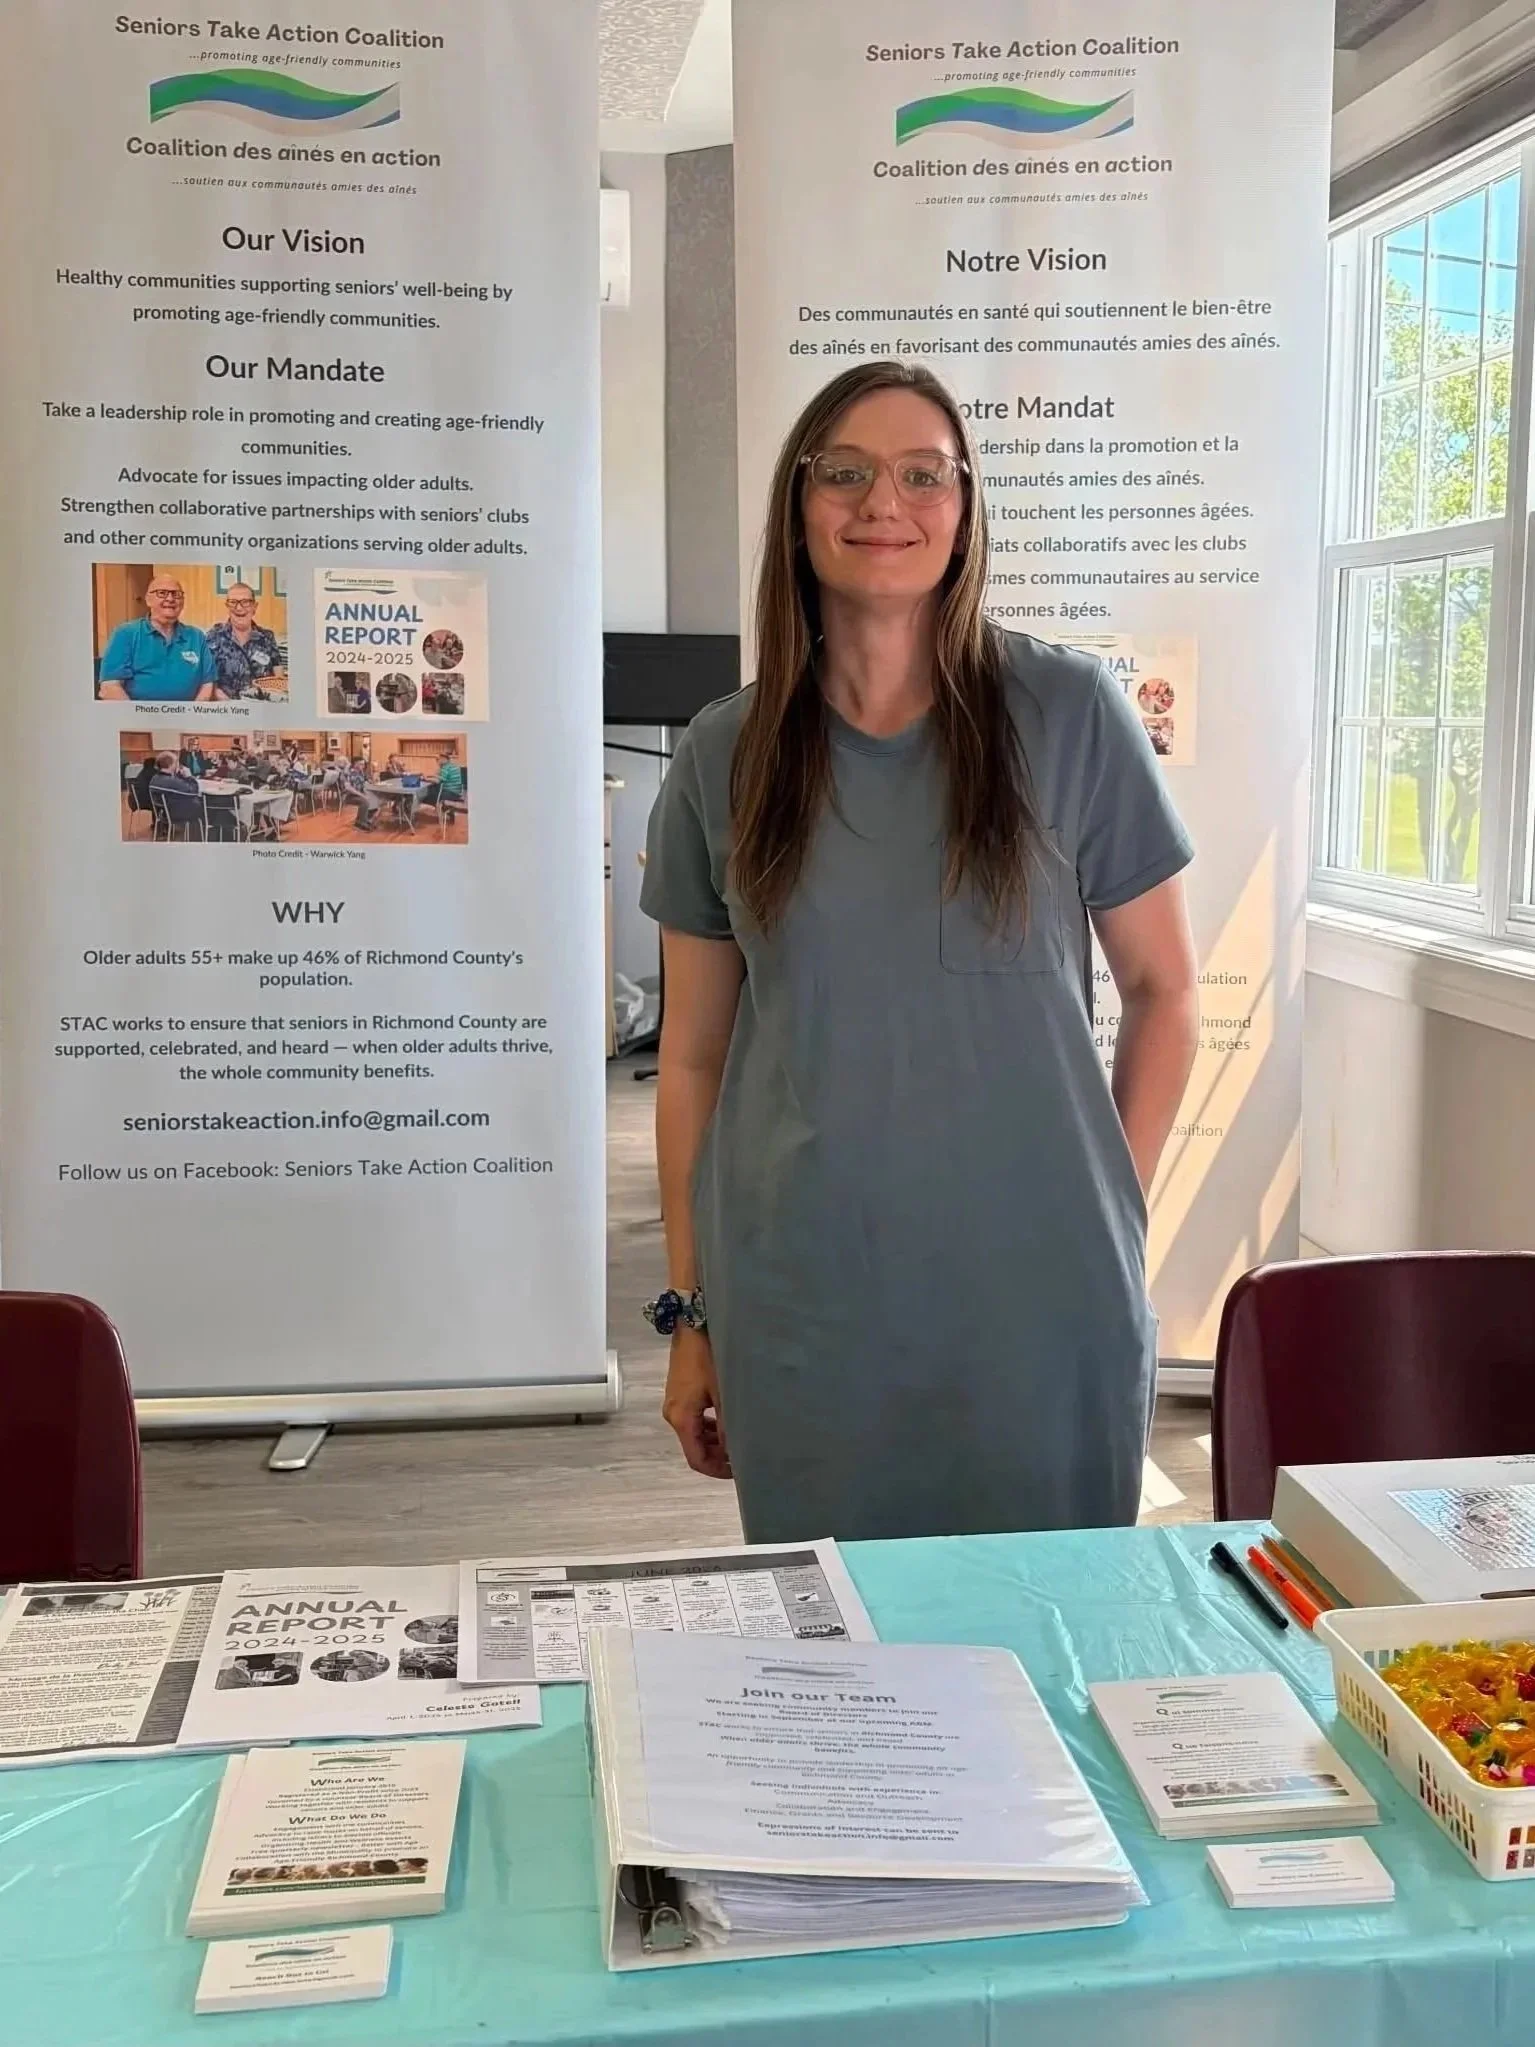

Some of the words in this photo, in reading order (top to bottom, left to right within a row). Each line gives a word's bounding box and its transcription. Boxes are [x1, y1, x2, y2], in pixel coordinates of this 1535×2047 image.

[114, 15, 201, 37] Seniors
[206, 19, 261, 41] Take
[265, 23, 339, 44] Action
[344, 27, 444, 49] Coalition
[865, 42, 946, 62] Seniors
[951, 41, 1002, 60] Take
[1005, 39, 1077, 59] Action
[1082, 36, 1179, 56] Coalition
[261, 53, 330, 68] age-friendly
[331, 55, 401, 70] communities
[1001, 69, 1066, 83] age-friendly
[1068, 66, 1137, 81] communities
[126, 136, 228, 158] Coalition
[232, 141, 273, 161] des
[277, 143, 336, 163] aînés
[339, 150, 367, 164] en
[371, 148, 441, 167] action
[873, 159, 968, 178] Coalition
[972, 158, 1010, 176] des
[1014, 156, 1070, 176] aînés
[1074, 160, 1100, 174] en
[1104, 154, 1173, 174] action
[227, 175, 248, 189] aux
[251, 175, 328, 191] communautés
[330, 183, 363, 193] amies
[366, 183, 385, 193] des
[388, 184, 417, 195] aînés
[222, 226, 276, 252] Our
[281, 228, 365, 255] Vision
[946, 249, 1020, 273] Notre
[1026, 247, 1107, 271] Vision
[56, 268, 124, 289] Healthy
[127, 273, 236, 291] communities
[240, 277, 332, 297] supporting
[334, 279, 399, 296] seniors'
[402, 281, 489, 302] well-being
[492, 283, 513, 302] by
[133, 304, 221, 325] promoting
[224, 307, 326, 328] age-friendly
[329, 312, 441, 329] communities.
[798, 306, 831, 322] Des
[835, 304, 954, 322] communautés
[957, 308, 979, 320] en
[983, 303, 1030, 320] santé
[1033, 301, 1061, 322] qui
[1064, 301, 1169, 319] soutiennent
[1172, 300, 1188, 317] le
[1192, 298, 1272, 316] bien-être
[789, 339, 819, 356] des
[821, 338, 866, 355] aînés
[870, 342, 891, 355] en
[895, 337, 980, 354] favorisant
[983, 336, 1014, 353] des
[1017, 335, 1138, 353] communautés
[1141, 333, 1192, 351] amies
[1196, 332, 1227, 350] des
[1230, 331, 1281, 349] aînés.
[205, 354, 259, 379] Our
[267, 356, 385, 383] Mandate
[961, 398, 1009, 420] otre
[1017, 394, 1115, 419] Mandat
[41, 401, 81, 418] Take
[85, 406, 96, 418] a
[100, 402, 188, 424] leadership
[191, 405, 225, 422] role
[228, 406, 245, 423] in
[249, 408, 336, 428] promoting
[339, 410, 371, 426] and
[374, 412, 442, 432] creating
[445, 413, 545, 435] age-friendly
[240, 440, 352, 457] communities.
[978, 437, 1041, 458] dership
[1045, 437, 1085, 454] dans
[1089, 437, 1104, 454] la
[1108, 436, 1198, 457] promotion
[1202, 437, 1220, 452] et
[1224, 435, 1239, 452] la
[982, 470, 1065, 488] munautés
[1068, 470, 1118, 487] amies
[1121, 469, 1152, 487] des
[1155, 469, 1205, 486] aînés.
[1000, 503, 1077, 521] touchent
[1080, 503, 1105, 520] les
[1108, 506, 1196, 523] personnes
[1200, 501, 1254, 522] âgées.
[1029, 568, 1171, 585] communautaires
[1173, 571, 1195, 584] au
[1199, 567, 1260, 584] service
[324, 602, 424, 623] ANNUAL
[982, 602, 1054, 618] ersonnes
[1059, 601, 1112, 621] âgées.
[324, 625, 418, 647] REPORT
[325, 650, 414, 666] 2024-2025
[135, 705, 160, 713] Photo
[160, 705, 186, 714] Credit
[192, 705, 229, 715] Warwick
[229, 706, 250, 717] Yang
[271, 901, 346, 924] WHY
[83, 949, 132, 965] Older
[135, 949, 187, 965] adults
[190, 950, 224, 965] 55+
[227, 949, 274, 965] make
[277, 953, 299, 968] up
[302, 949, 341, 966] 46%
[343, 949, 363, 965] of
[366, 949, 448, 965] Richmond
[452, 949, 524, 968] County's
[259, 970, 353, 990] population.
[1196, 971, 1248, 985] ulation
[60, 1016, 109, 1032] STAC
[111, 1016, 164, 1032] works
[167, 1017, 186, 1033] to
[189, 1019, 247, 1031] ensure
[250, 1015, 286, 1031] that
[288, 1015, 349, 1031] seniors
[352, 1015, 368, 1030] in
[372, 1014, 455, 1030] Richmond
[458, 1014, 518, 1032] County
[521, 1017, 548, 1029] are
[1200, 1015, 1252, 1029] hmond
[123, 1108, 490, 1132] seniorstakeaction.info@gmail.com
[58, 1163, 122, 1181] Follow
[127, 1167, 148, 1180] us
[153, 1167, 177, 1180] on
[183, 1160, 279, 1179] Facebook:
[284, 1160, 353, 1177] Seniors
[357, 1159, 403, 1176] Take
[407, 1157, 468, 1177] Action
[473, 1156, 553, 1174] Coalition
[230, 1600, 408, 1619] ANNUAL
[225, 1616, 396, 1636] REPORT
[224, 1633, 386, 1651] 2024-2025
[740, 1687, 785, 1699] Join
[791, 1692, 829, 1702] our
[833, 1693, 897, 1704] Team
[310, 1778, 344, 1786] Who
[288, 1816, 327, 1825] What
